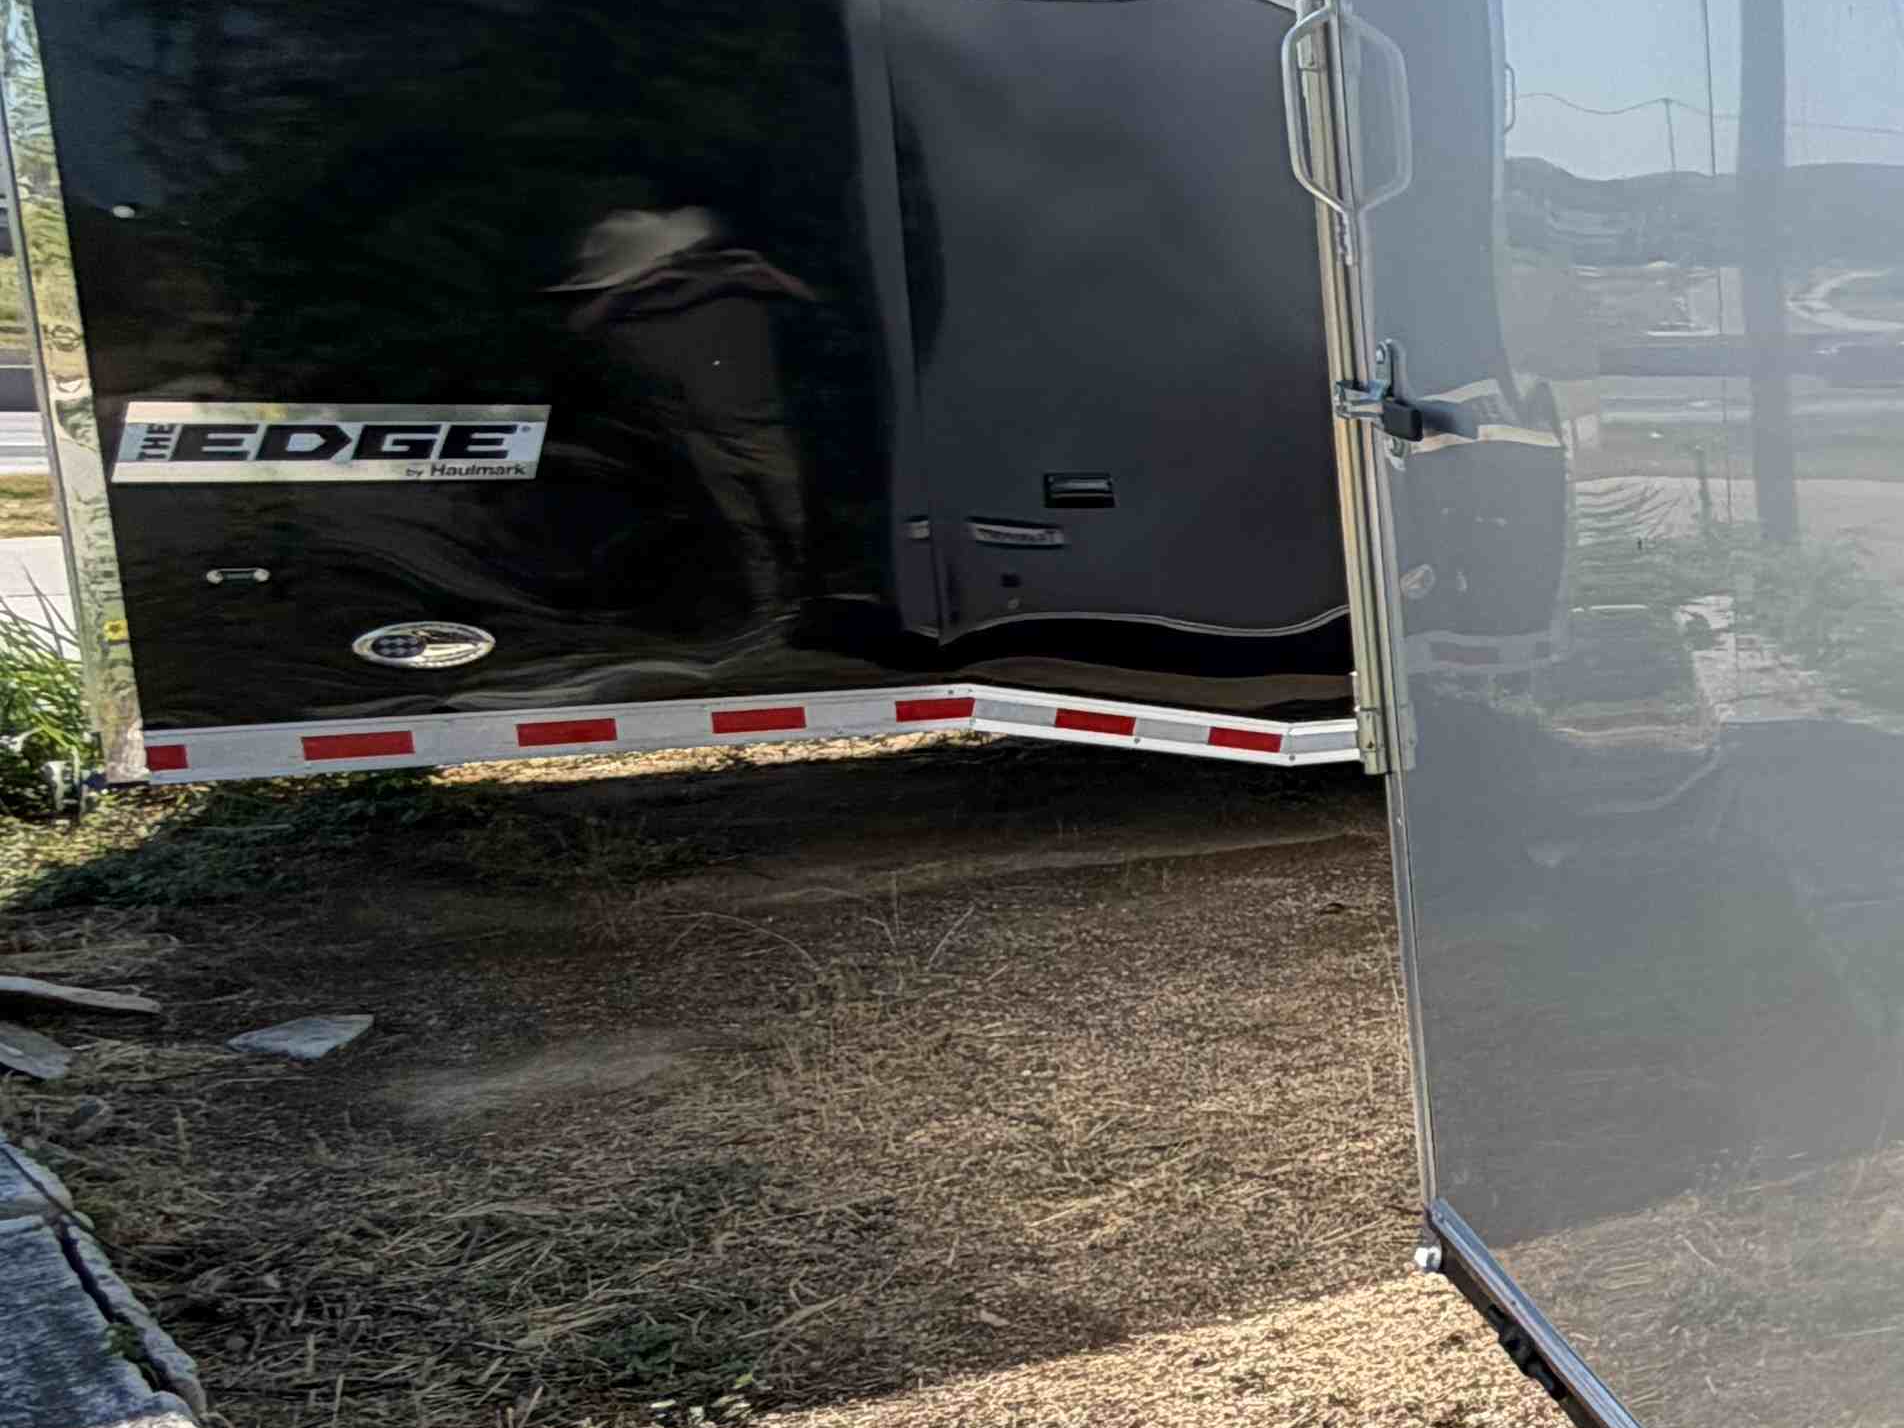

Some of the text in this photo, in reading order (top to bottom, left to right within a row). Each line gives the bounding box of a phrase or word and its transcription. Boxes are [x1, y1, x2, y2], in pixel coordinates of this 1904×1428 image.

[136, 423, 518, 461] THE EDGE
[431, 464, 527, 477] Haulmark
